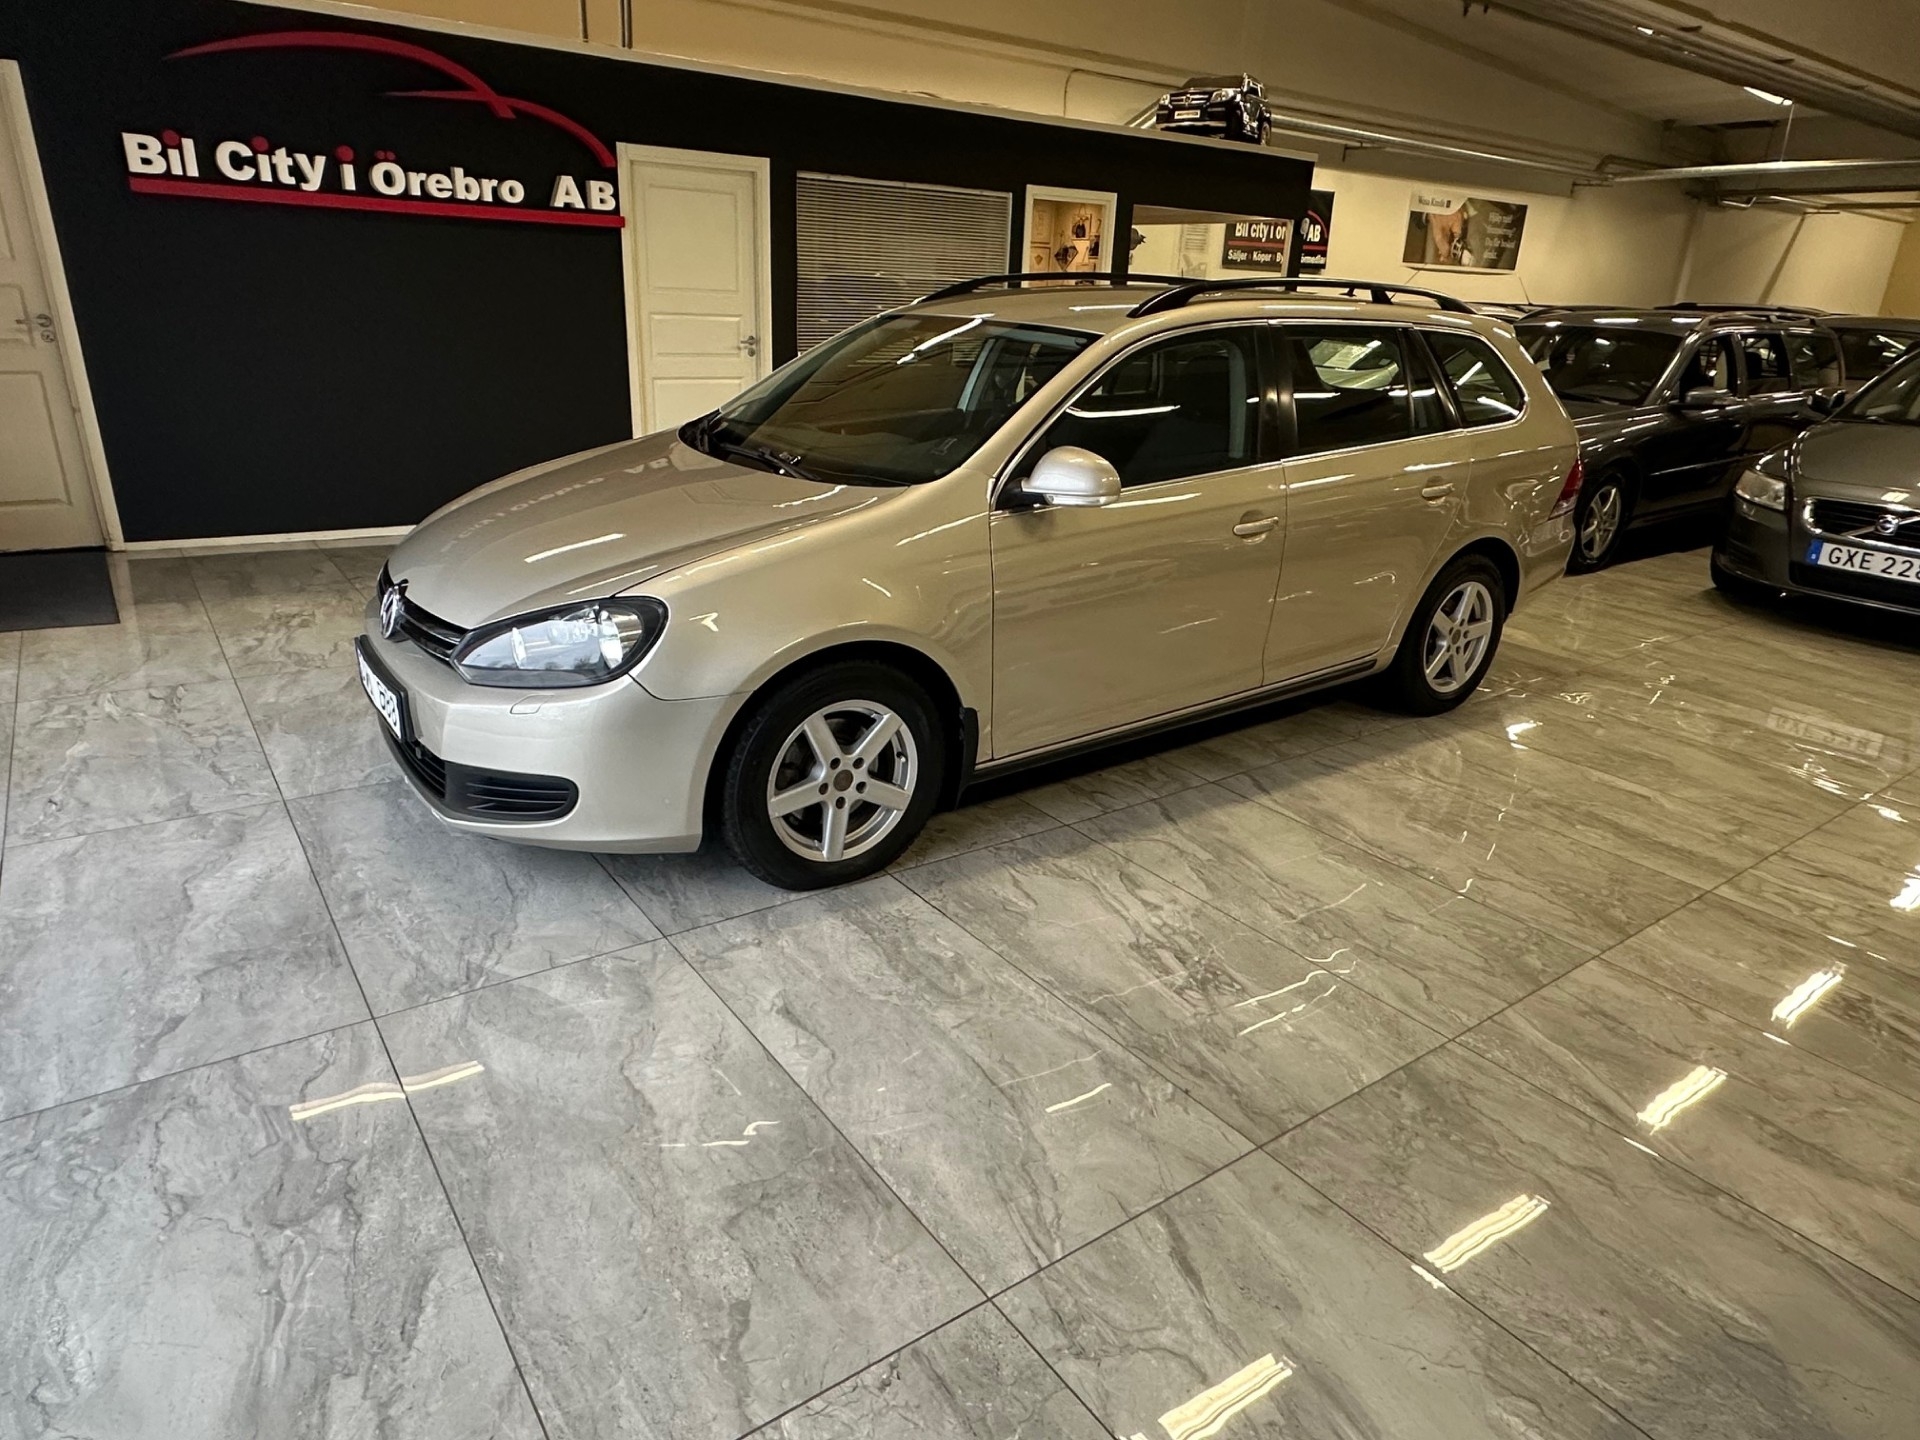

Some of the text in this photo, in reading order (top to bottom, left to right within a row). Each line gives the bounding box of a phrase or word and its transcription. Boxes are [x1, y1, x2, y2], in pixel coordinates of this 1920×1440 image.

[121, 129, 616, 211] Bil City i Örebro AB
[1307, 224, 1322, 242] AB
[1252, 250, 1272, 263] Köper
[1828, 547, 1875, 570] GXE
